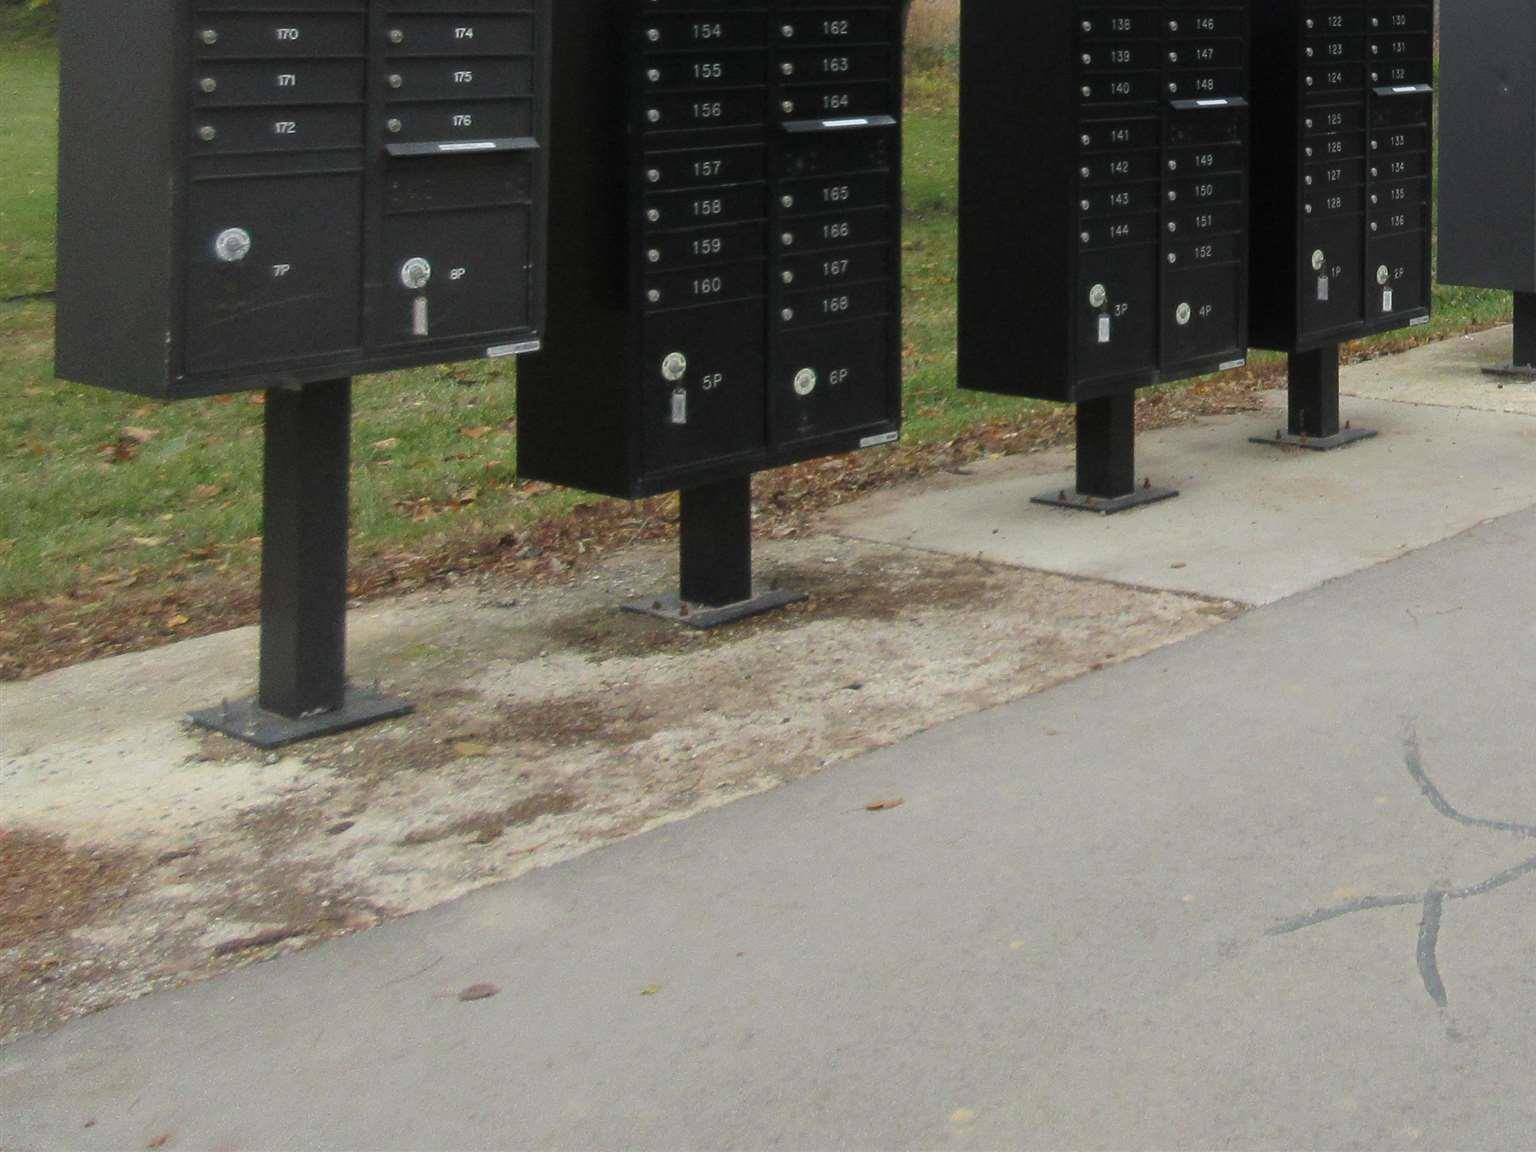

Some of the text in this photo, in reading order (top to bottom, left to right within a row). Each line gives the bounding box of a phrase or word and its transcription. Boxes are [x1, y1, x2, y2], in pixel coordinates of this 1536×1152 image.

[693, 23, 722, 39] 154
[823, 20, 848, 35] 162
[1111, 18, 1131, 31] 138
[1196, 18, 1215, 30] 146
[276, 28, 299, 40] 170
[454, 27, 474, 39] 174
[1111, 50, 1131, 63] 139
[1196, 47, 1214, 60] 147
[693, 63, 722, 79] 155
[823, 57, 849, 72] 163
[277, 73, 296, 87] 171
[453, 71, 473, 83] 175
[1111, 81, 1130, 95] 140
[1196, 78, 1214, 91] 148
[823, 94, 849, 109] 164
[274, 121, 296, 134] 172
[452, 114, 472, 127] 176
[1111, 129, 1129, 141] 141
[1195, 153, 1214, 166] 149
[693, 160, 722, 176] 157
[1110, 160, 1129, 174] 142
[823, 185, 849, 201] 165
[1110, 192, 1129, 206] 143
[693, 199, 722, 215] 158
[823, 222, 849, 238] 166
[1110, 224, 1129, 238] 144
[693, 238, 721, 255] 159
[272, 263, 291, 277] 7P
[449, 267, 466, 280] 8P
[823, 259, 849, 276] 167
[693, 276, 721, 294] 160
[702, 373, 723, 391] 5P
[829, 368, 849, 385] 6P
